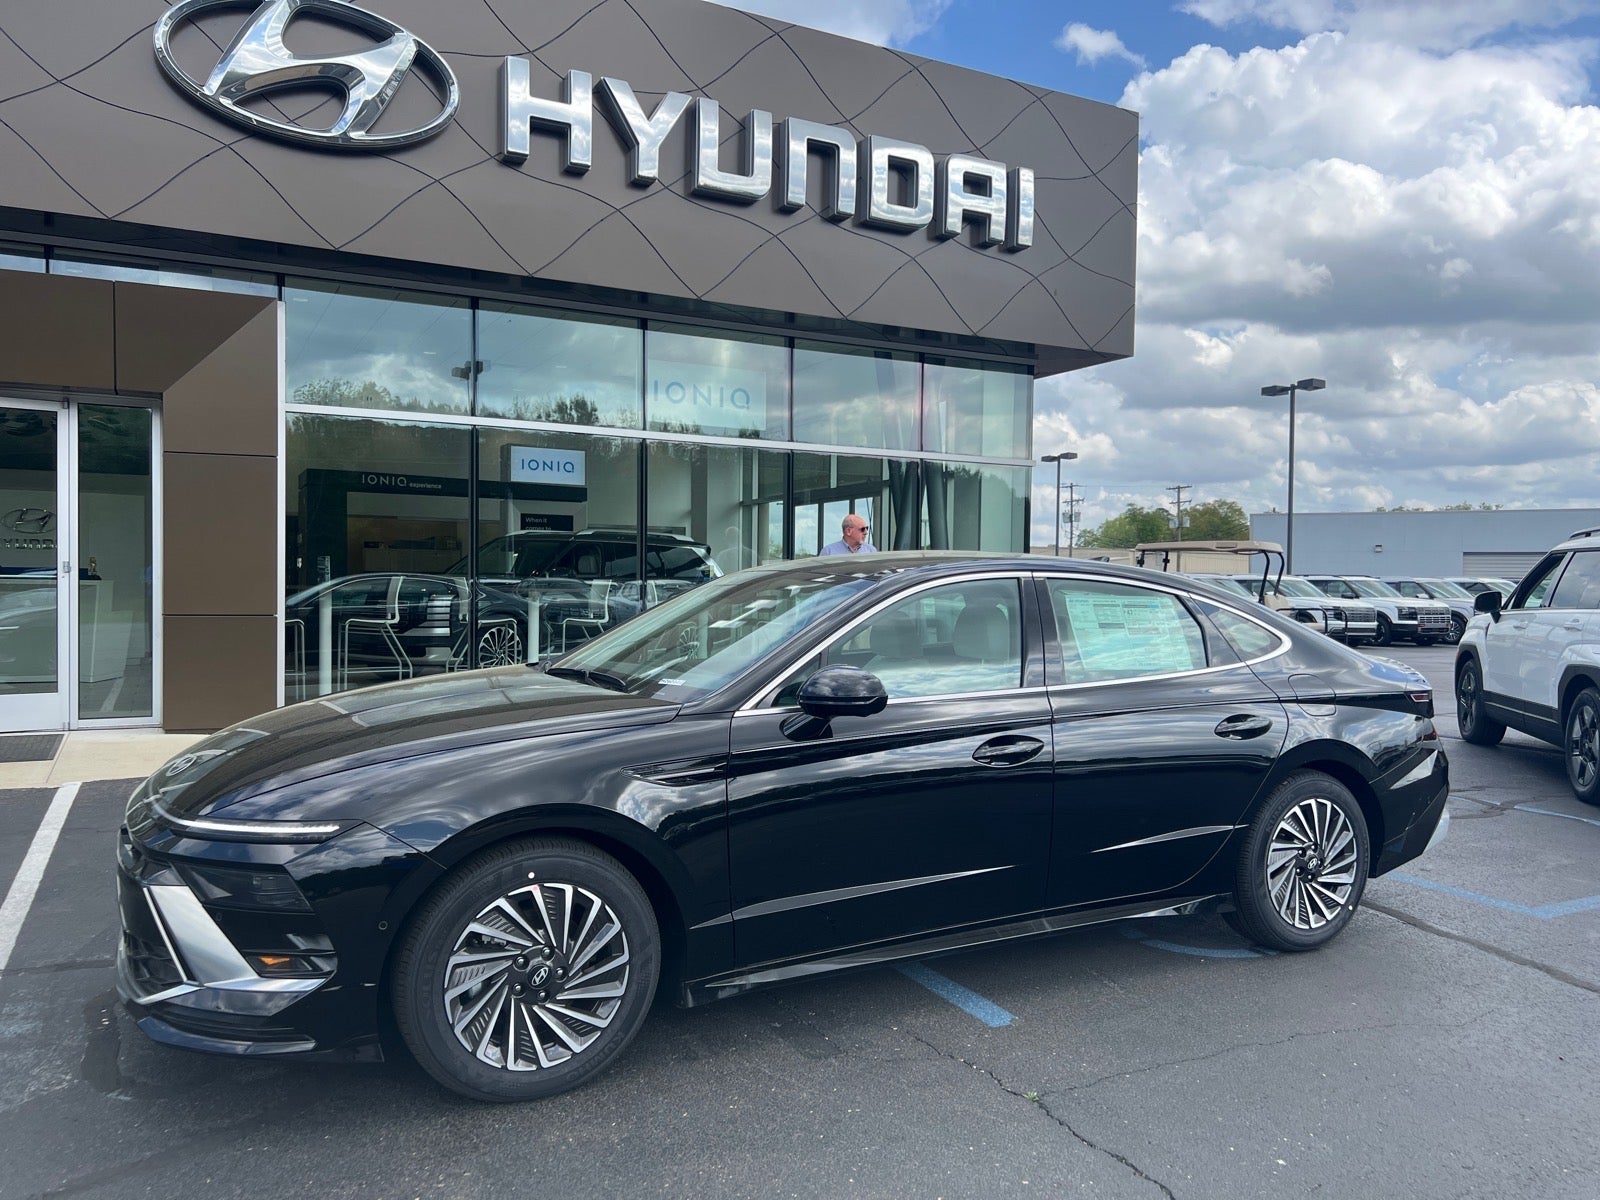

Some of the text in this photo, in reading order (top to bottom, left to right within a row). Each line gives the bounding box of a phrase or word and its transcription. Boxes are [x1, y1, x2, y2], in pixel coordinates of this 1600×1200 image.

[500, 55, 1035, 252] HYUNDAI
[653, 379, 751, 410] IONIQ
[521, 458, 575, 473] IONIQ
[362, 473, 407, 487] IONIQ
